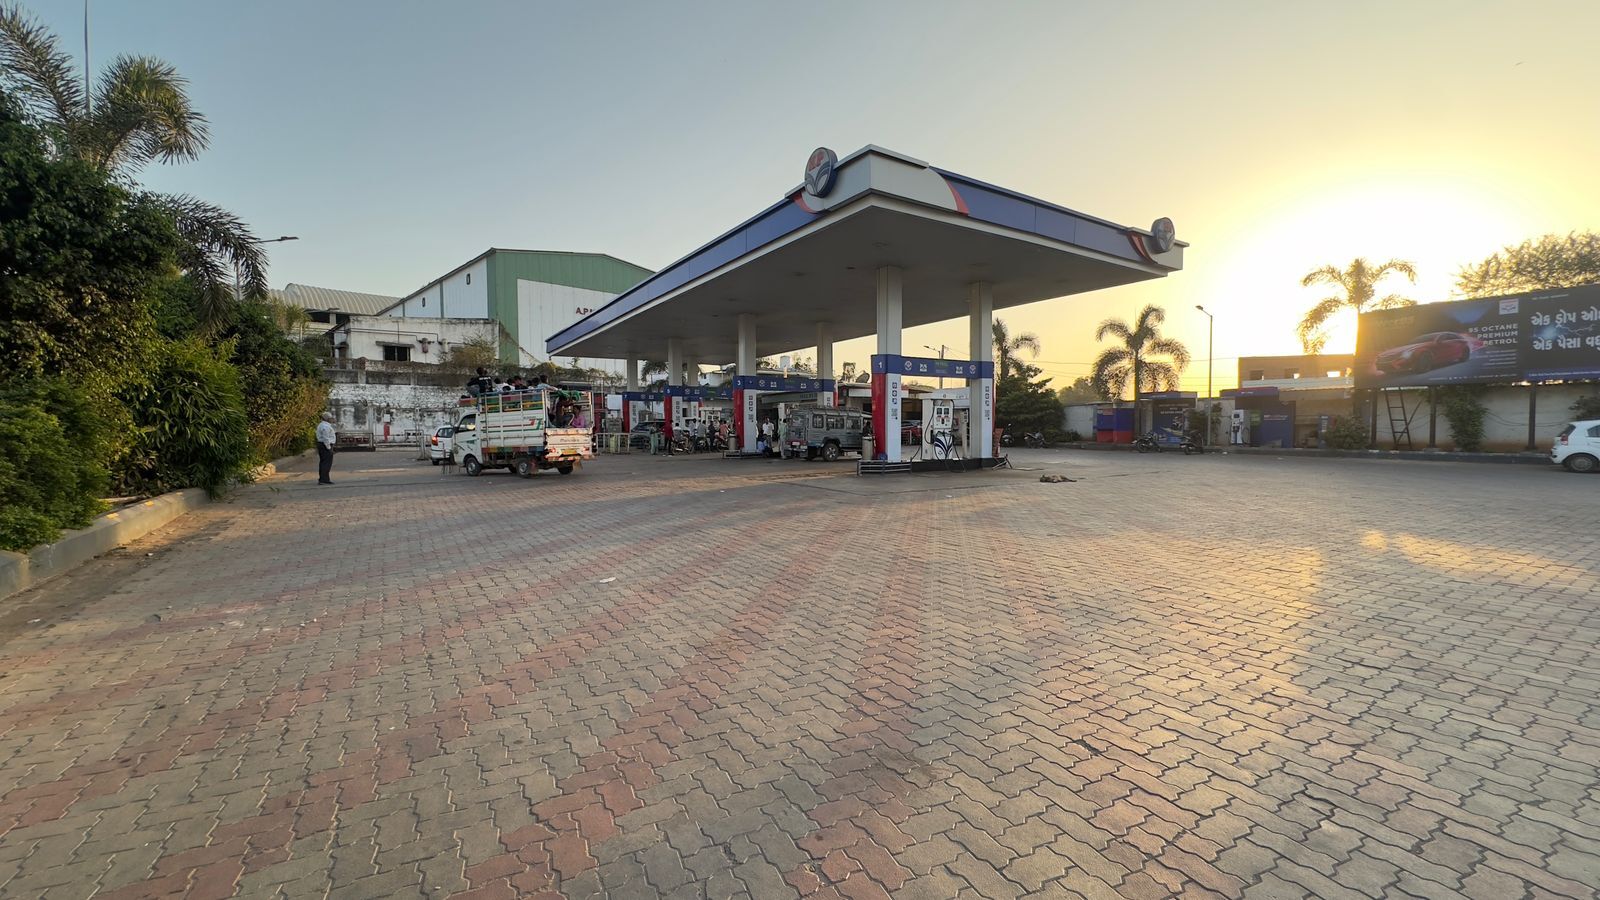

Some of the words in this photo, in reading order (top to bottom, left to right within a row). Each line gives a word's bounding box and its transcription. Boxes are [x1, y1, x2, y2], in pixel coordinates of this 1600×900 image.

[1531, 312, 1550, 326] એક
[1581, 306, 1600, 321] ઓ
[1481, 323, 1518, 332] OCTANE
[1478, 330, 1518, 339] PREMIUM
[1483, 338, 1518, 346] PETROL
[1533, 337, 1553, 350] એક
[878, 361, 883, 369] 1
